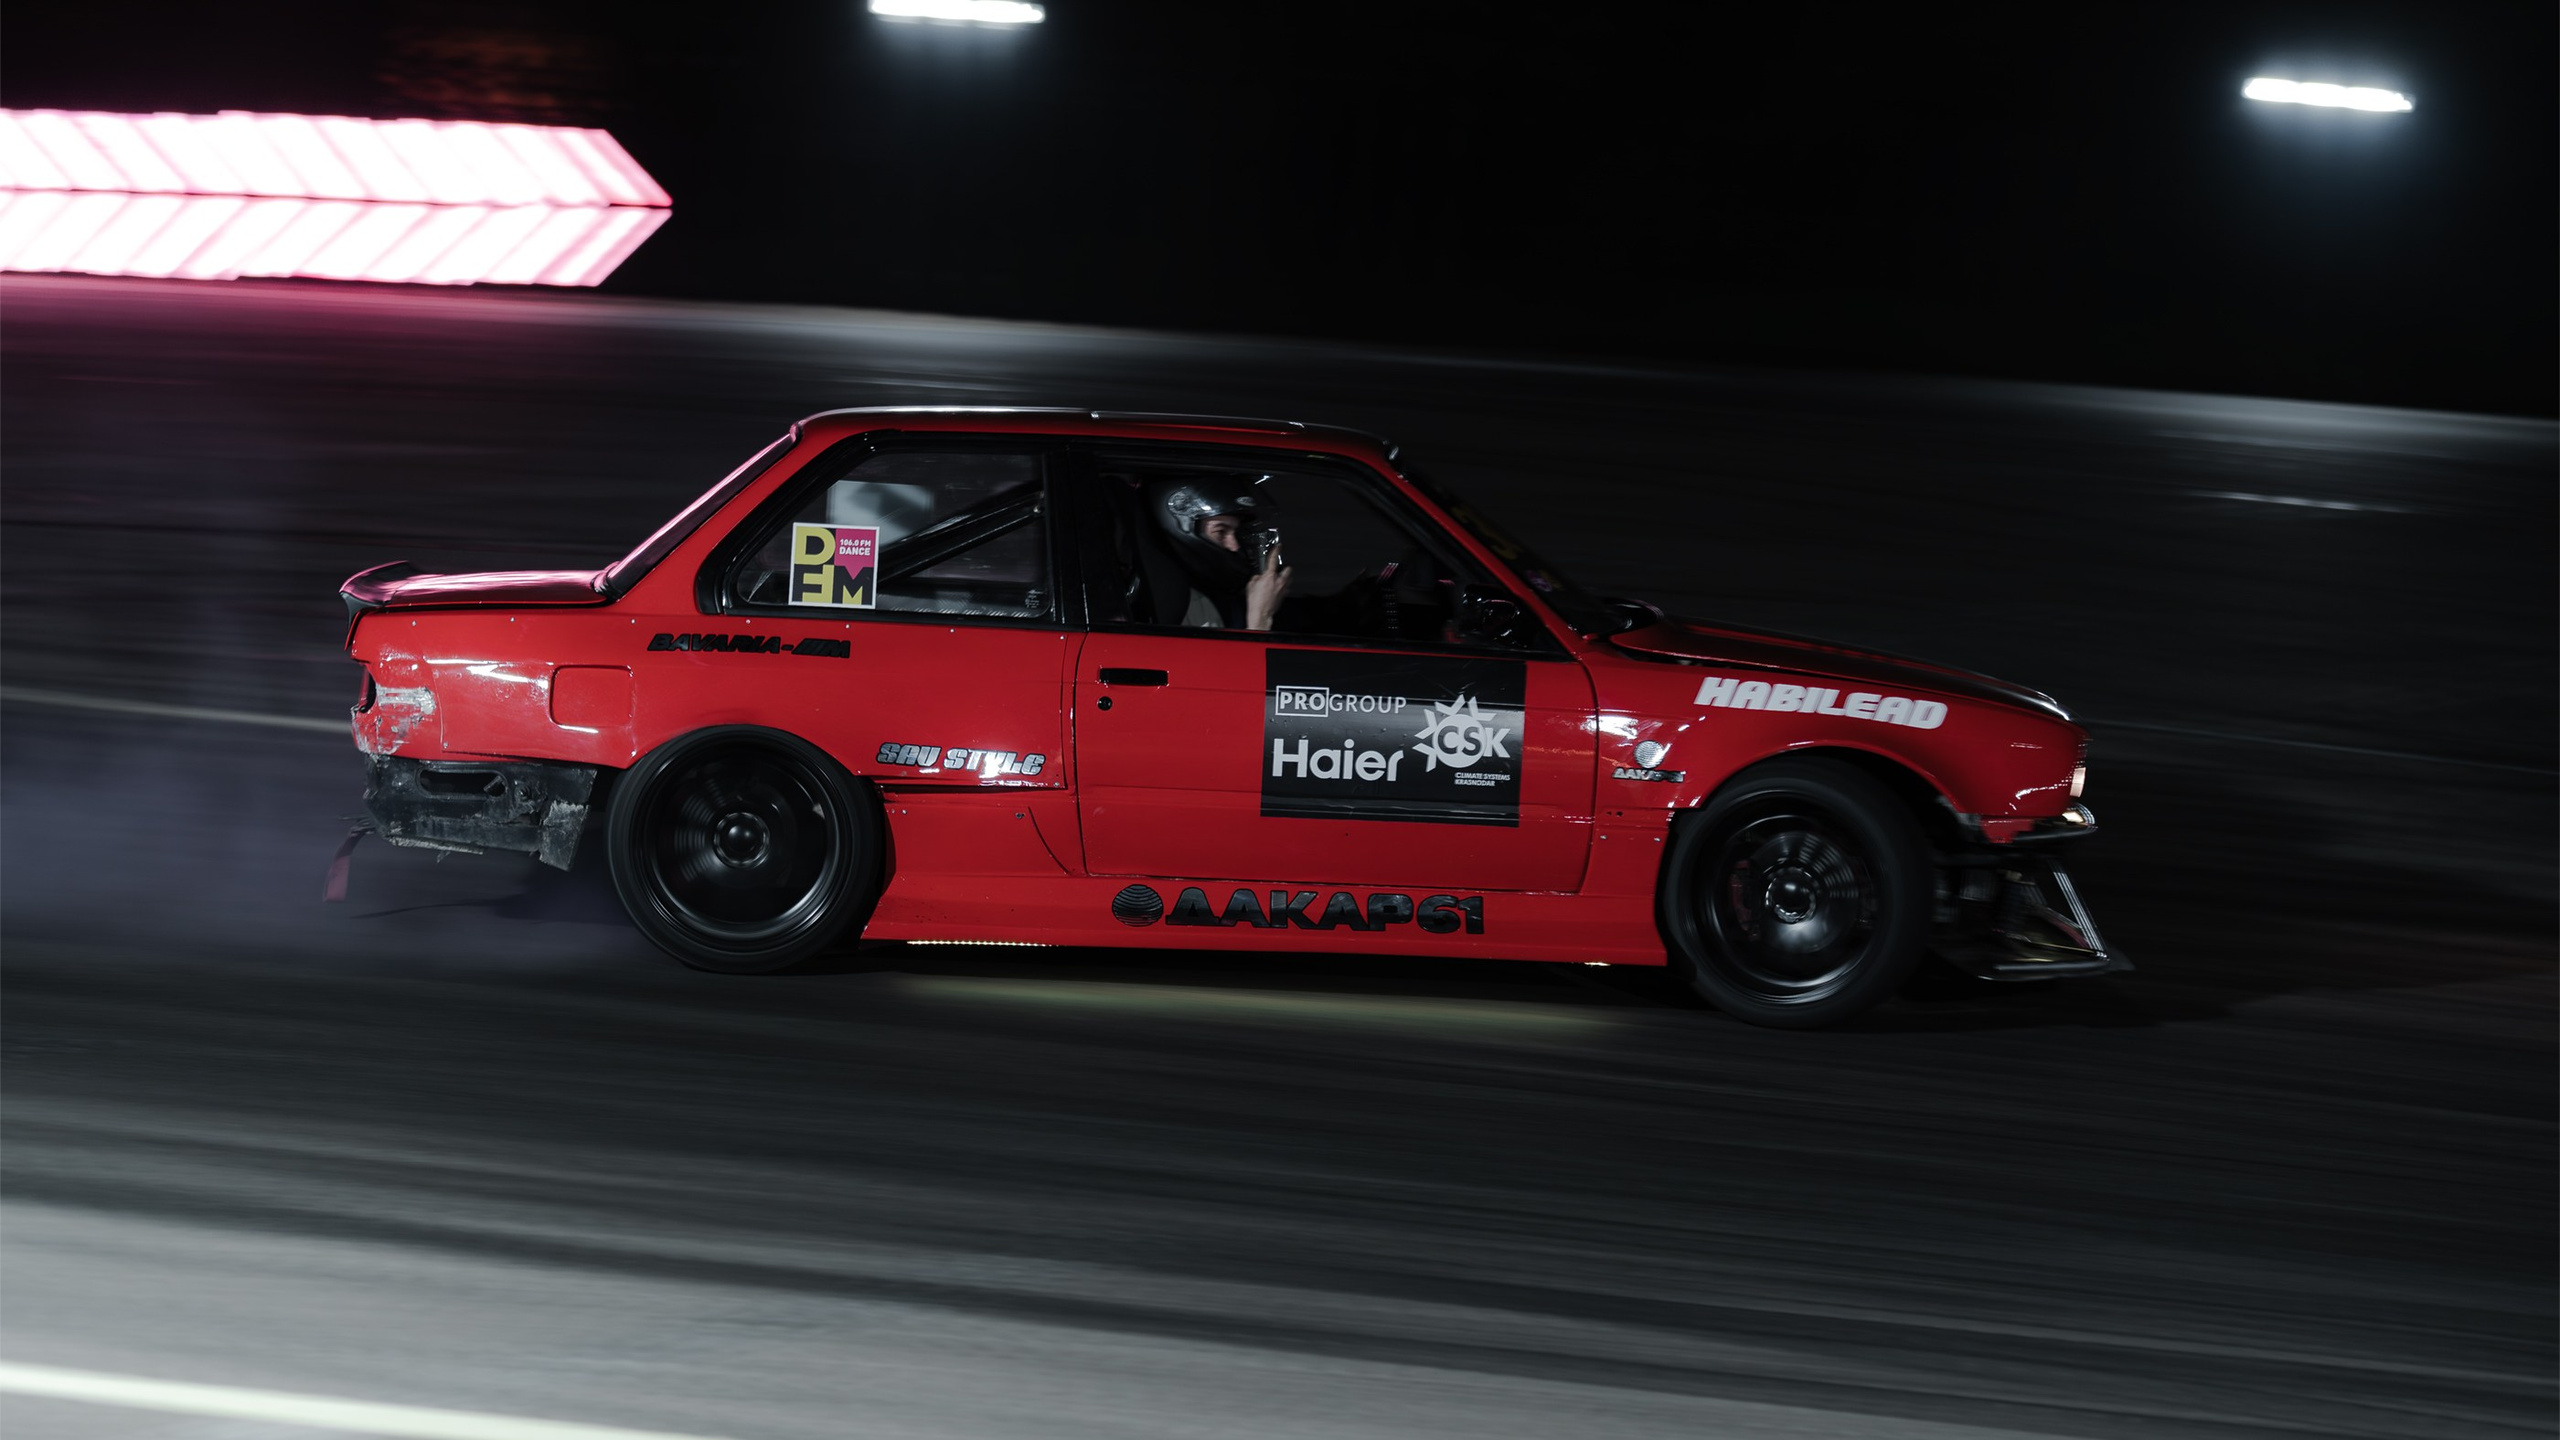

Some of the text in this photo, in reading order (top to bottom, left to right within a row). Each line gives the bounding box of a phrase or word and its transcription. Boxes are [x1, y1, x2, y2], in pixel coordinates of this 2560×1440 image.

[839, 547, 871, 556] DANCE
[840, 539, 859, 547] 106.0
[1694, 676, 1948, 730] HABILEAD
[1437, 725, 1511, 758] CSK
[943, 748, 1046, 776] STYLE
[1272, 738, 1404, 781] Haier
[1454, 772, 1511, 781] CLIMATE SYSTEMS
[1454, 779, 1496, 787] KRASNODAR
